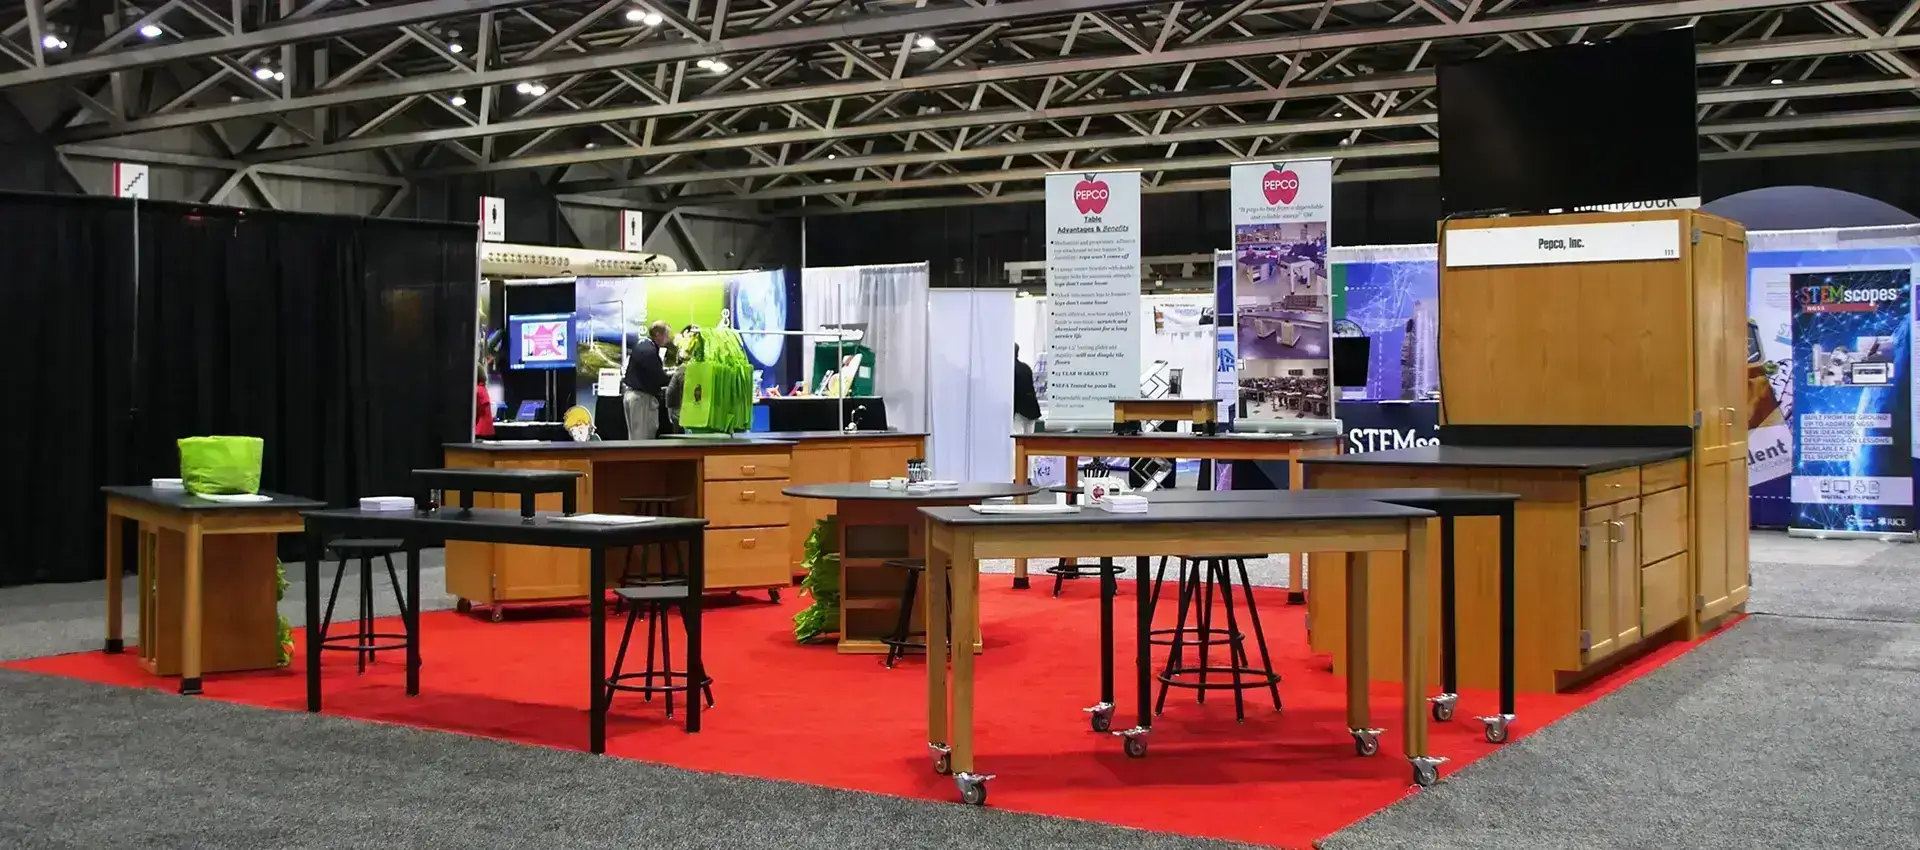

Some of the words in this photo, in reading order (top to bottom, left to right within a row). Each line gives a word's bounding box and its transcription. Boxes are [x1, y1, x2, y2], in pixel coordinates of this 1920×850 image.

[1264, 179, 1298, 190] PEPCO
[1076, 190, 1108, 200] PEPCO
[1057, 226, 1094, 234] Advantages
[1102, 224, 1129, 232] Benefits
[1538, 238, 1566, 252] Pepco,
[1568, 236, 1585, 248] Inc.
[1801, 284, 1898, 306] STEMscopes
[1036, 466, 1051, 477] K-12
[1886, 518, 1906, 526] RICE
